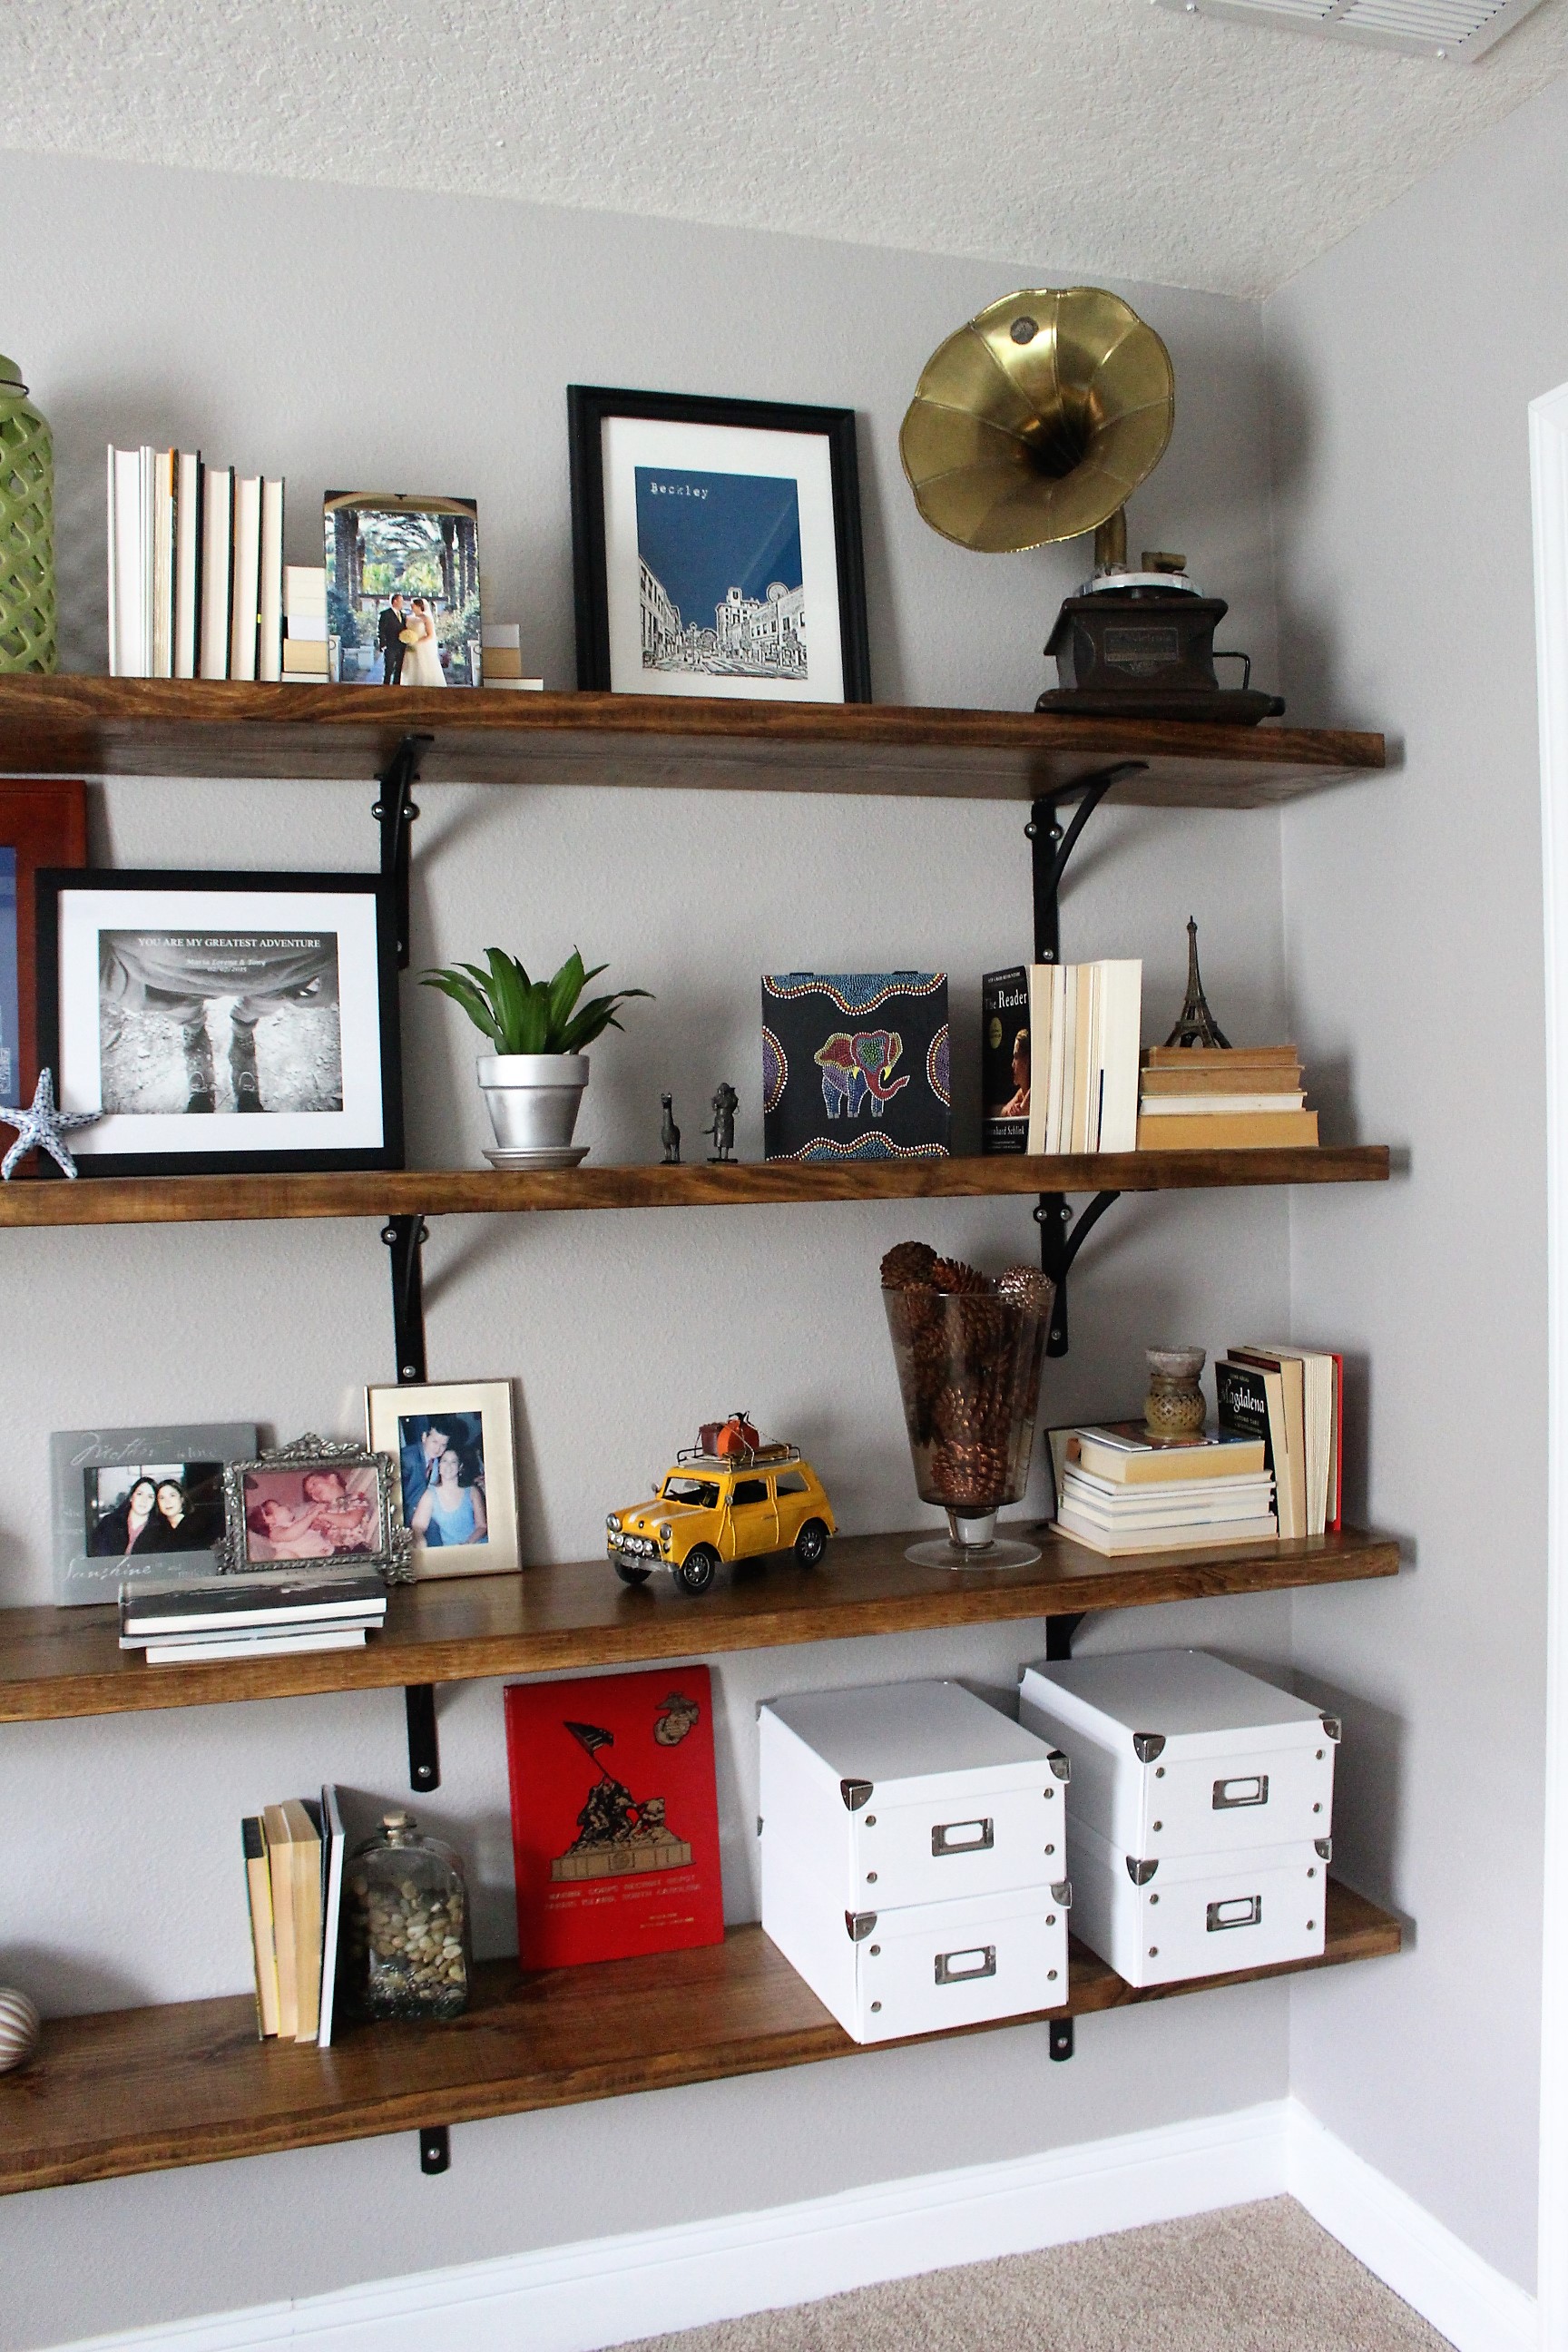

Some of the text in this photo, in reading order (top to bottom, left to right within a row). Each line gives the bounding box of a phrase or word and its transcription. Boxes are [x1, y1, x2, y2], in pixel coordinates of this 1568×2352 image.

[651, 482, 708, 499] Beckley
[138, 938, 321, 948] YOU ARE MY GREATEST ADVENTURE
[985, 989, 1027, 1010] The Reader
[1219, 1378, 1265, 1413] Magdalena
[64, 1554, 152, 1583] Sunshine
